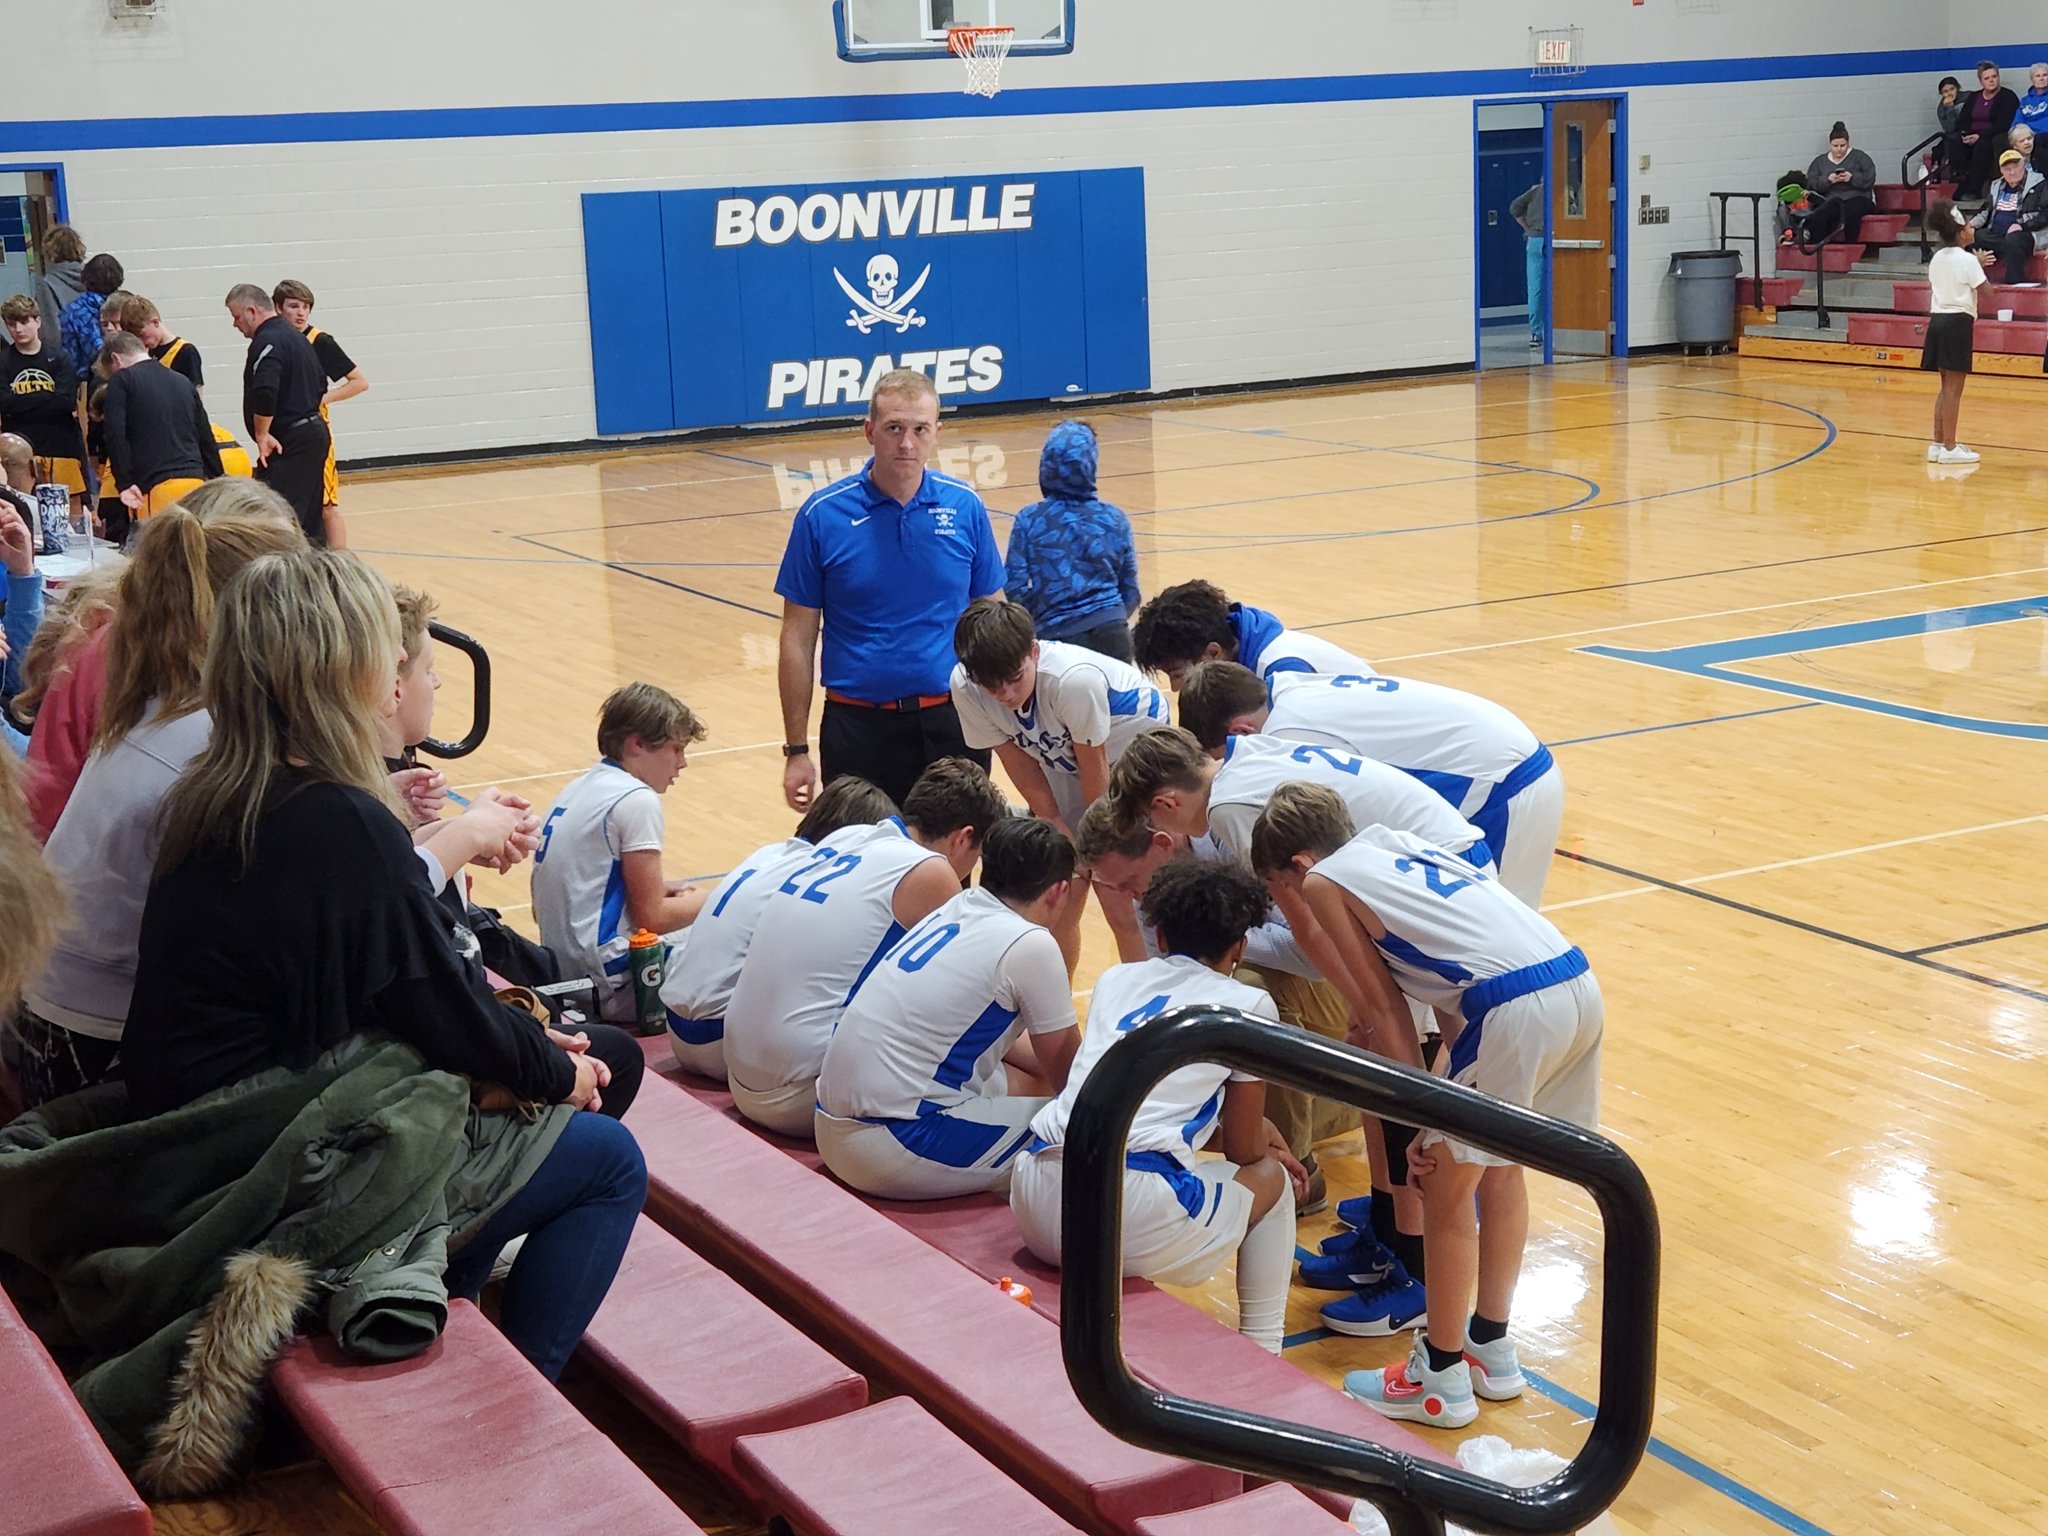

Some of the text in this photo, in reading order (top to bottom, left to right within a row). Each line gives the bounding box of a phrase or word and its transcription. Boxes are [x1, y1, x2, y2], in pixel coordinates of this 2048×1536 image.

[1545, 41, 1566, 60] EXIT
[714, 183, 1036, 248] BOONVILLE
[766, 344, 1003, 410] PIRATES
[1329, 674, 1400, 693] 3
[1290, 744, 1363, 776] 2
[535, 806, 568, 865] 5
[711, 868, 758, 918] 1
[778, 846, 863, 905] 22
[884, 912, 961, 974] 10
